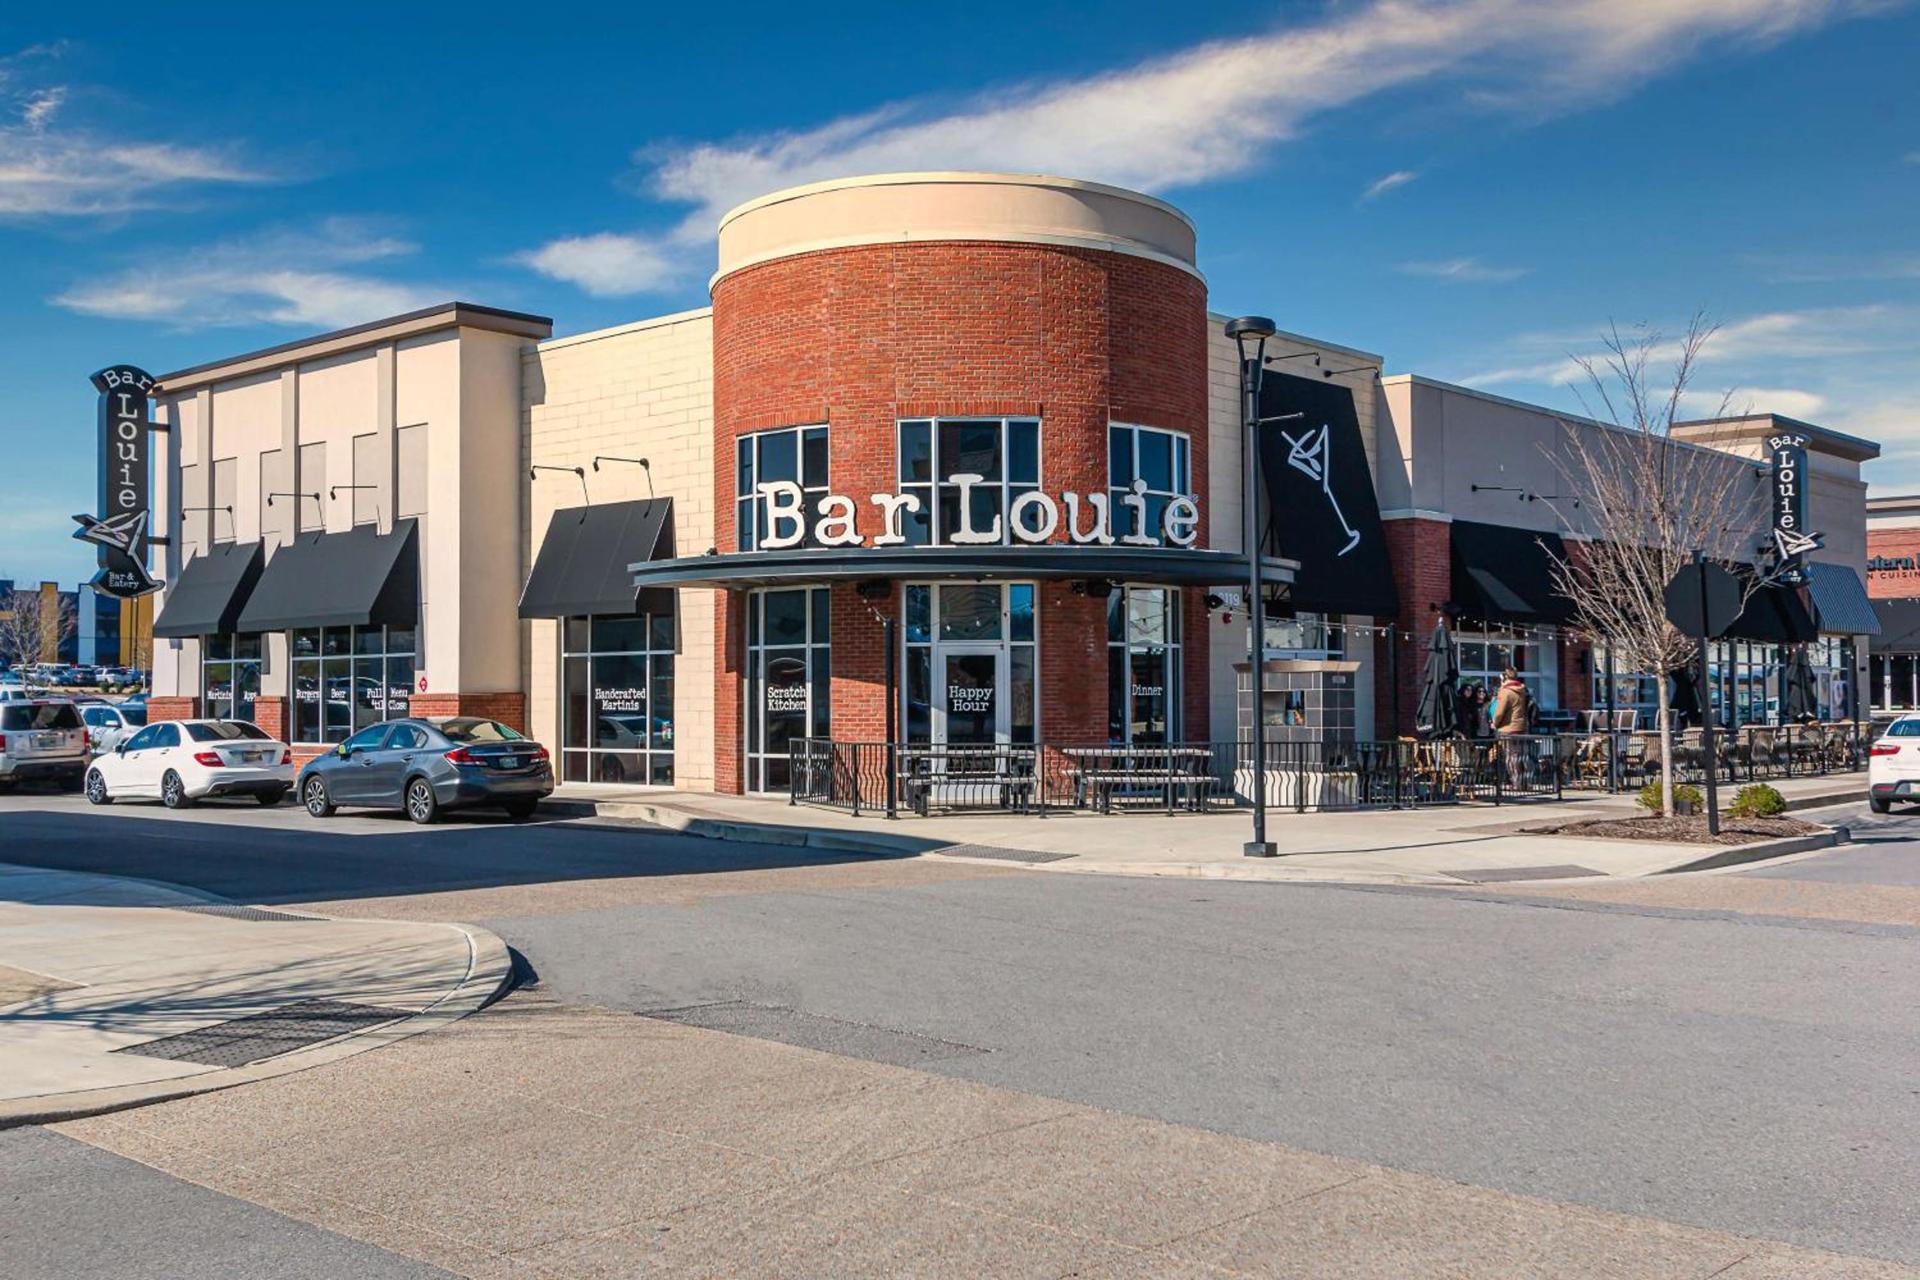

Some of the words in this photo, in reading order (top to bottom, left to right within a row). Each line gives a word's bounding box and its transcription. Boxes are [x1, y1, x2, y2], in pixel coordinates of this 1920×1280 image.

[103, 370, 152, 390] Bar
[1769, 435, 1804, 450] Bar
[117, 393, 138, 508] Louie
[1778, 451, 1795, 528] Louie
[758, 480, 921, 549] Bar
[948, 473, 1200, 545] Louie
[108, 571, 126, 581] Bar
[127, 572, 136, 581] &
[331, 688, 347, 699] Beer
[366, 688, 383, 699] Full
[390, 687, 408, 698] Menu
[594, 688, 647, 700] Handcrafted
[767, 686, 807, 699] Scratch
[948, 685, 993, 700] Happy
[1131, 684, 1164, 696] Dinner
[388, 699, 408, 711] Close
[602, 700, 640, 711] Martinis
[767, 699, 808, 711] Kitchen
[952, 699, 990, 712] Hour
